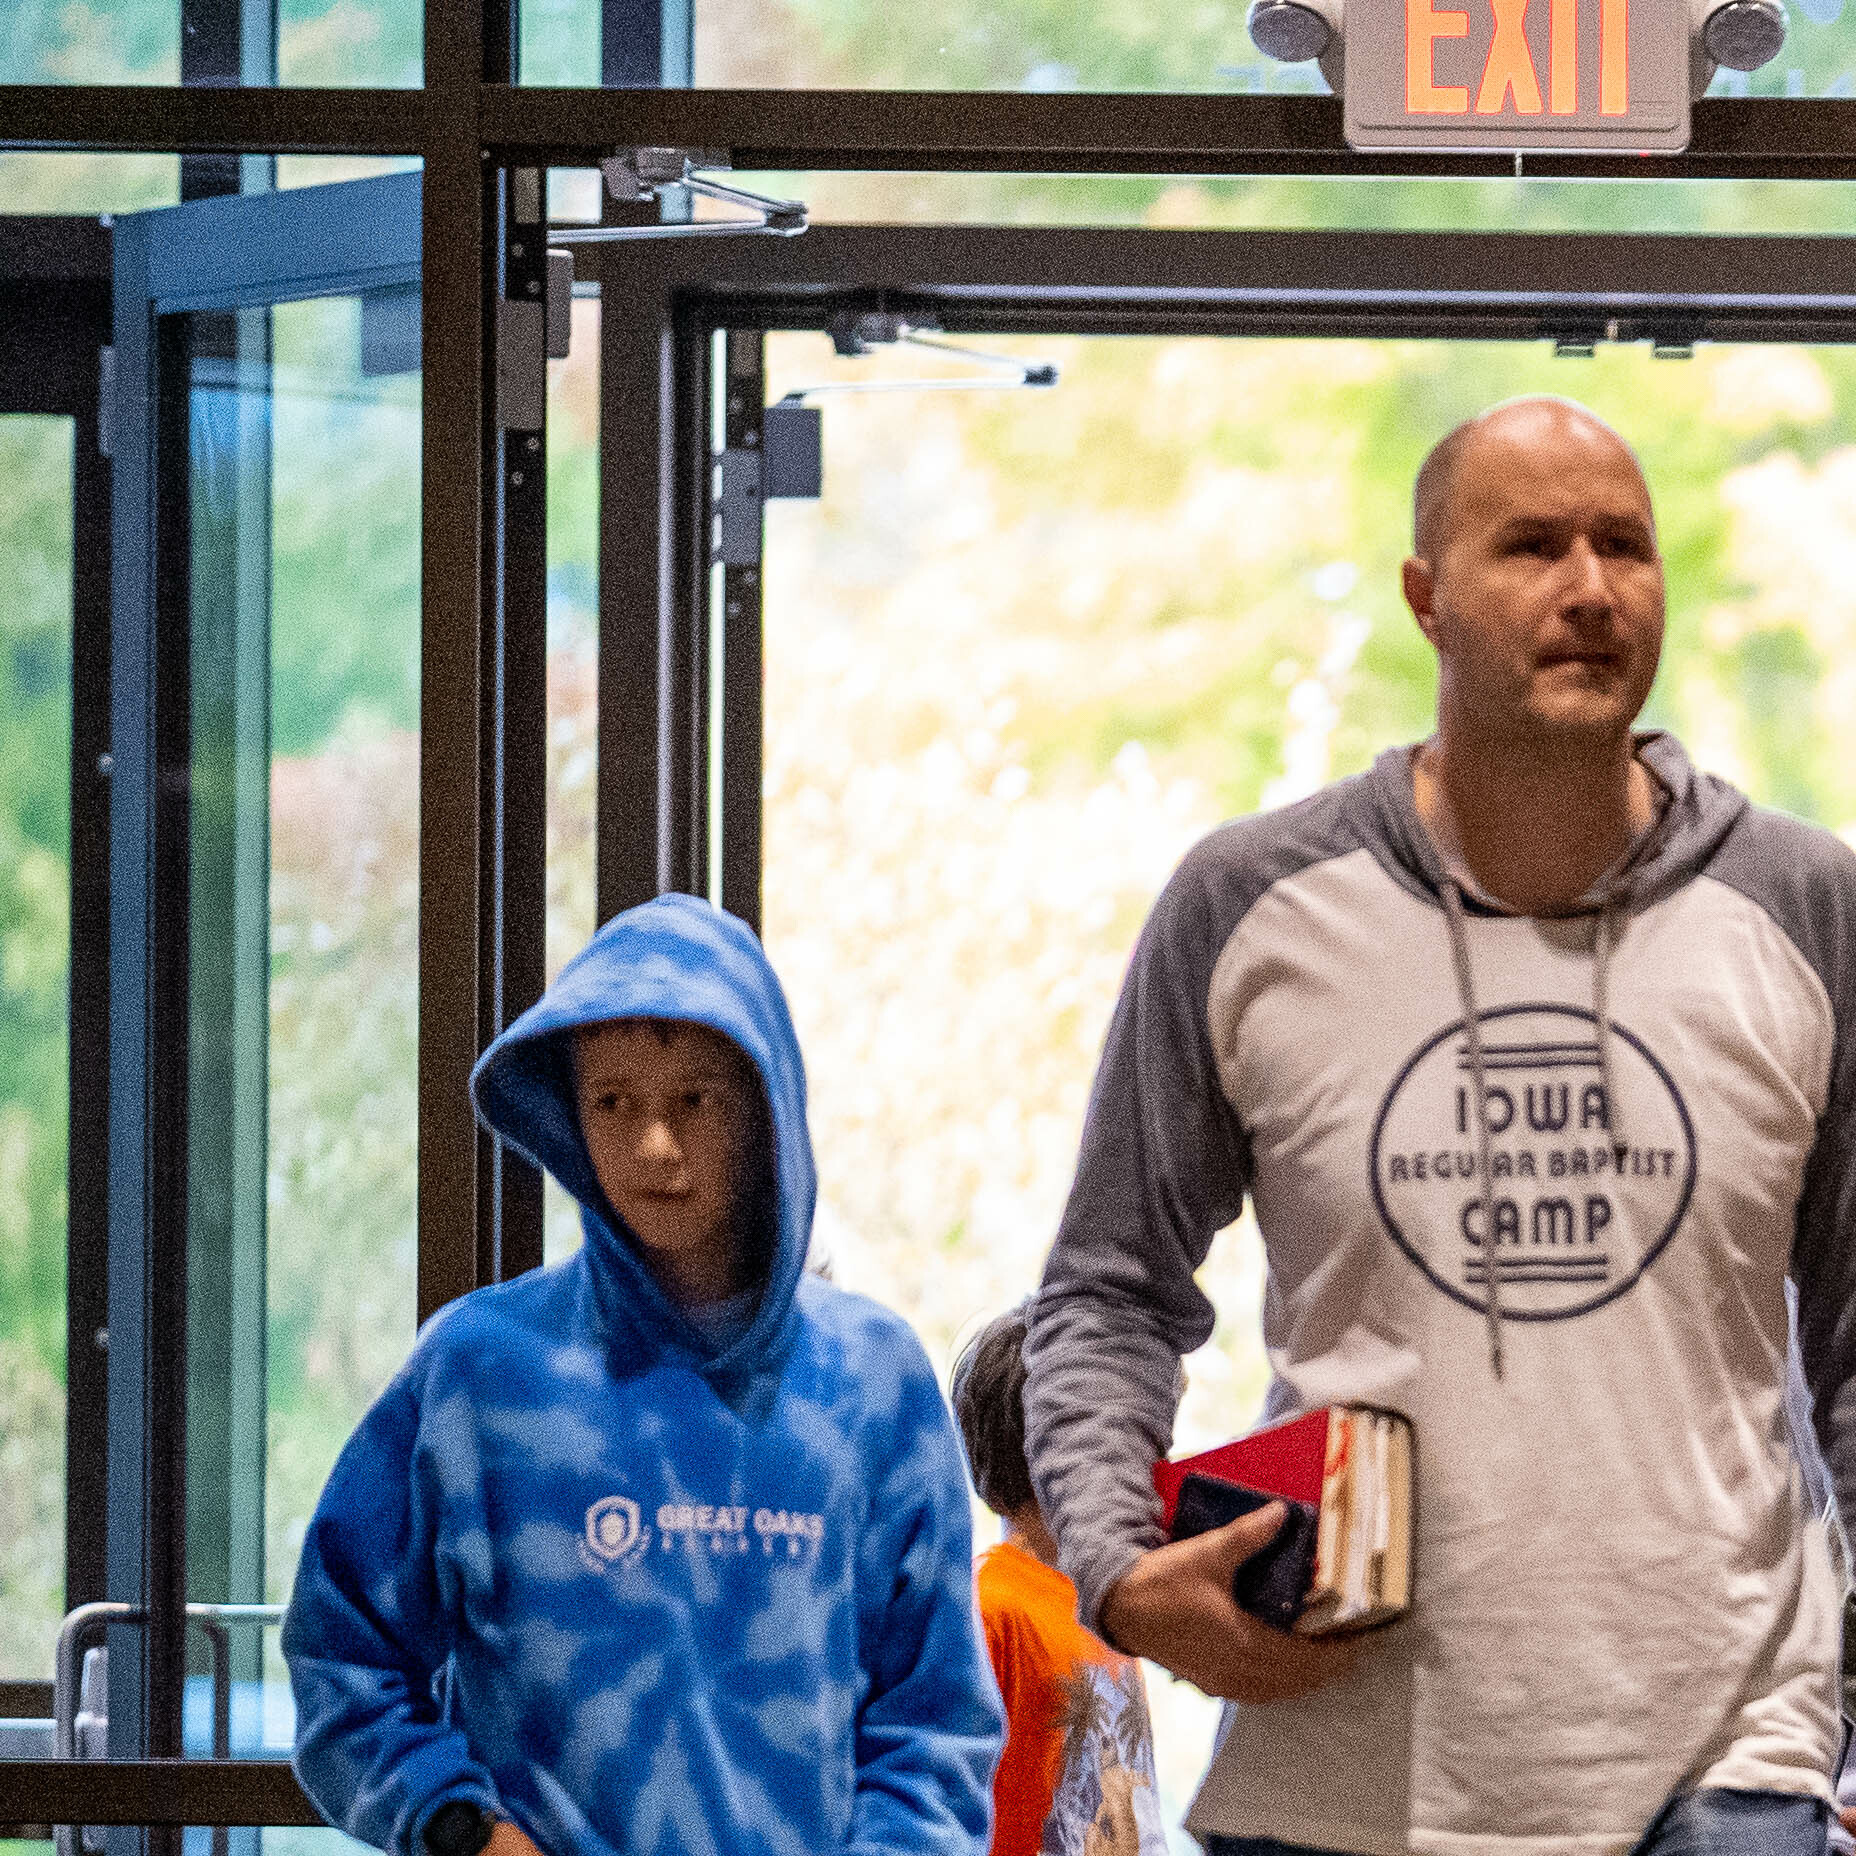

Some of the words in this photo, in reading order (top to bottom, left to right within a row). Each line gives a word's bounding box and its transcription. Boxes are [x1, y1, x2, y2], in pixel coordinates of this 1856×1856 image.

[1457, 1084, 1609, 1133] IOWA
[1389, 1151, 1536, 1181] REGUAR
[1461, 1195, 1613, 1246] CAMP
[656, 1504, 749, 1531] GREAT
[754, 1508, 824, 1538] OAKS
